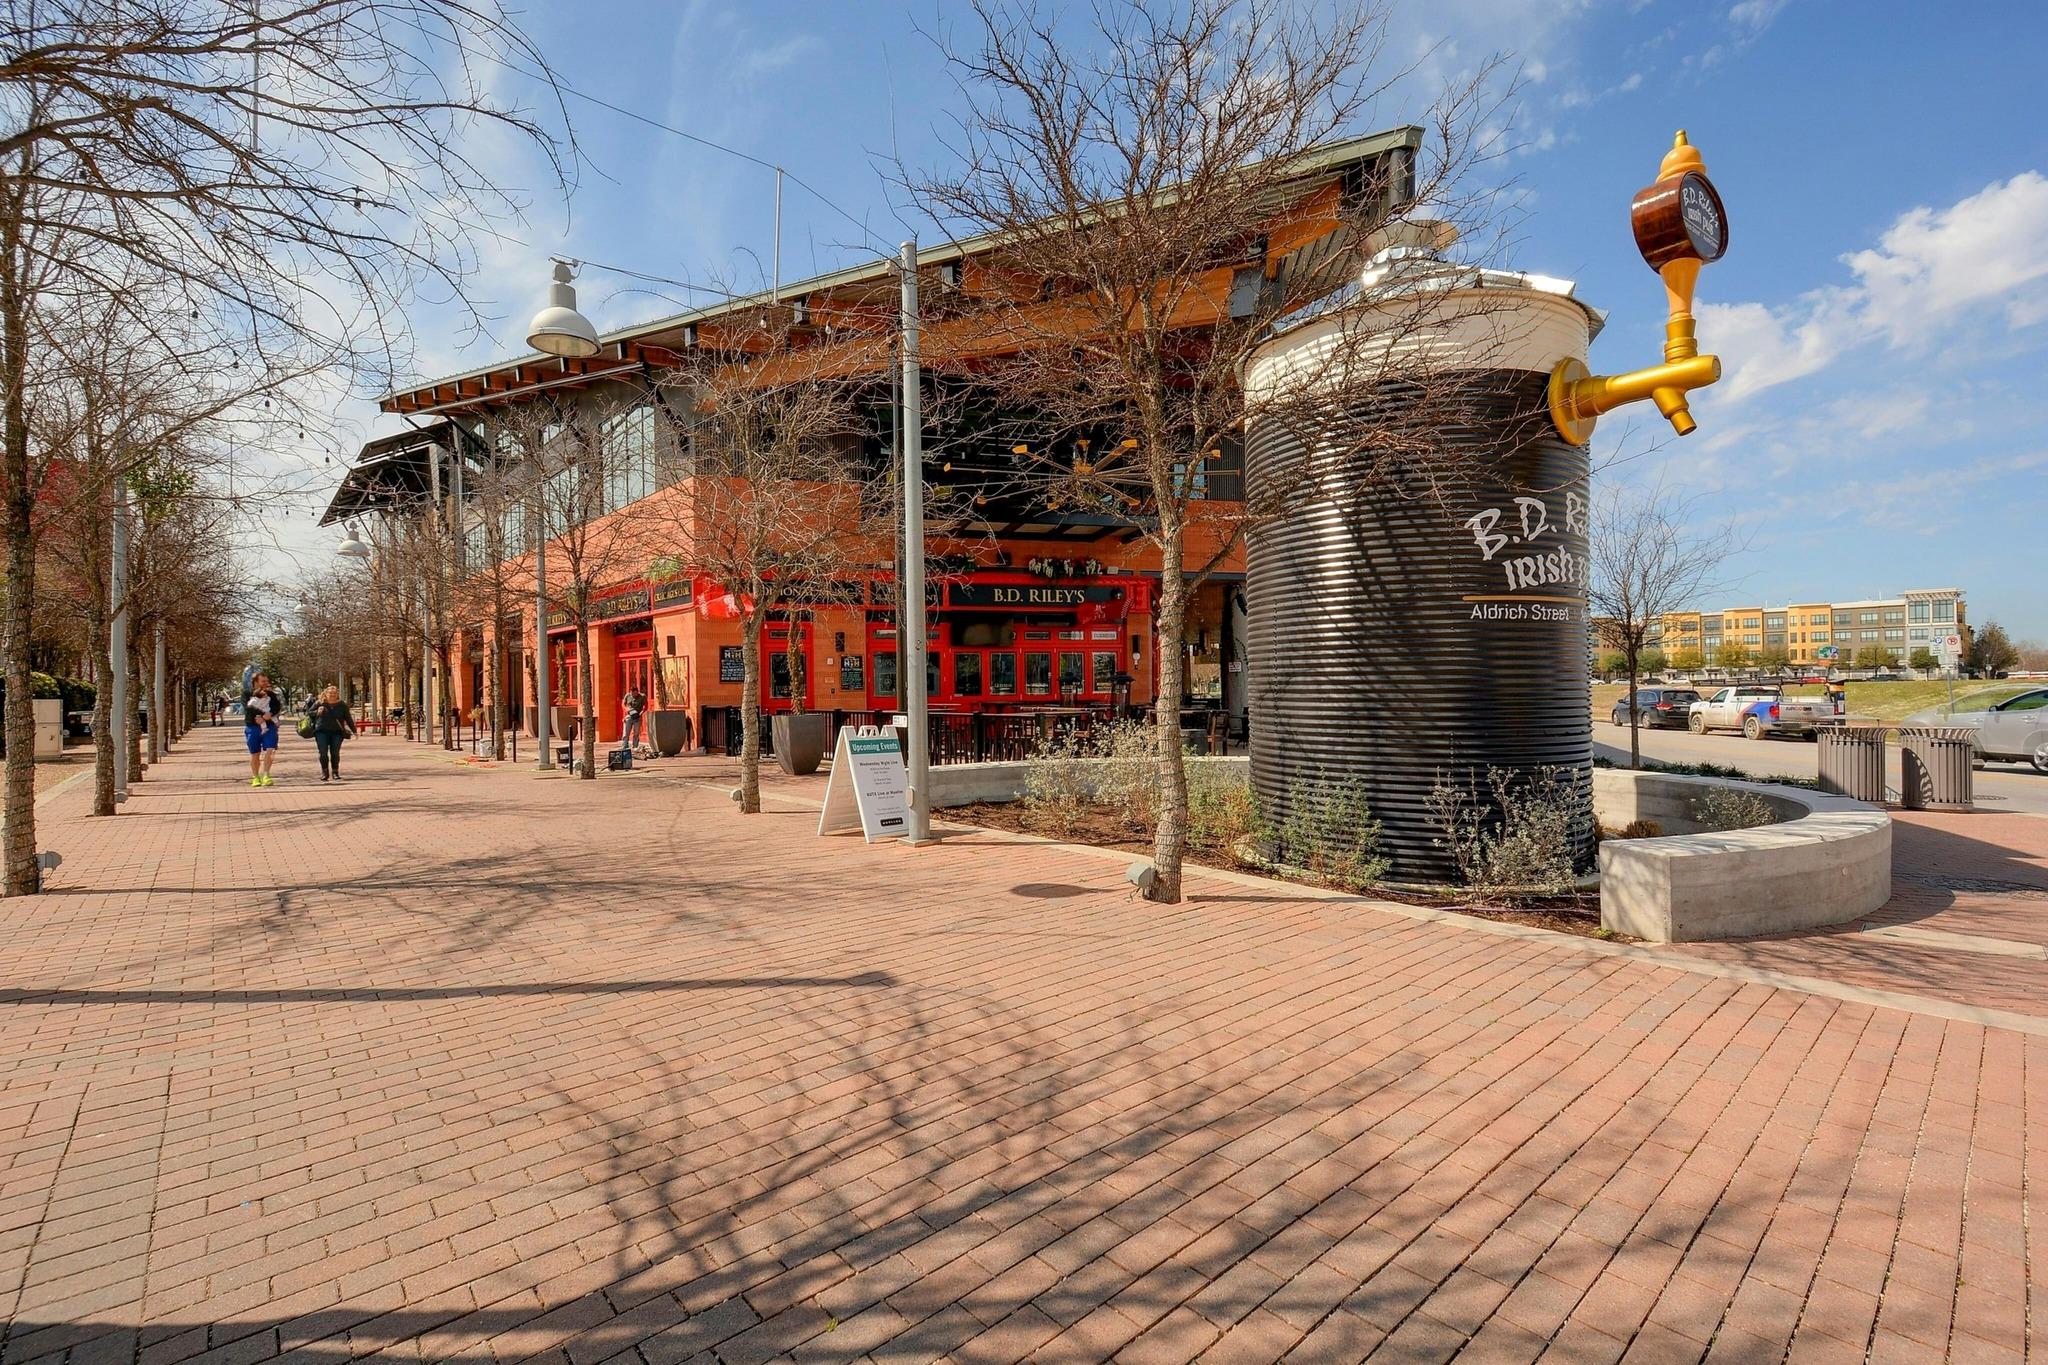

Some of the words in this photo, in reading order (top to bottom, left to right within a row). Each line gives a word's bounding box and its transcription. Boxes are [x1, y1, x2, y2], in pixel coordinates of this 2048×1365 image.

[994, 588, 1023, 602] B.D.
[1029, 588, 1085, 603] RILEY'S
[1470, 603, 1527, 619] Aldrich
[1531, 604, 1569, 620] Street
[852, 743, 880, 752] Upcoming
[880, 742, 898, 750] Events
